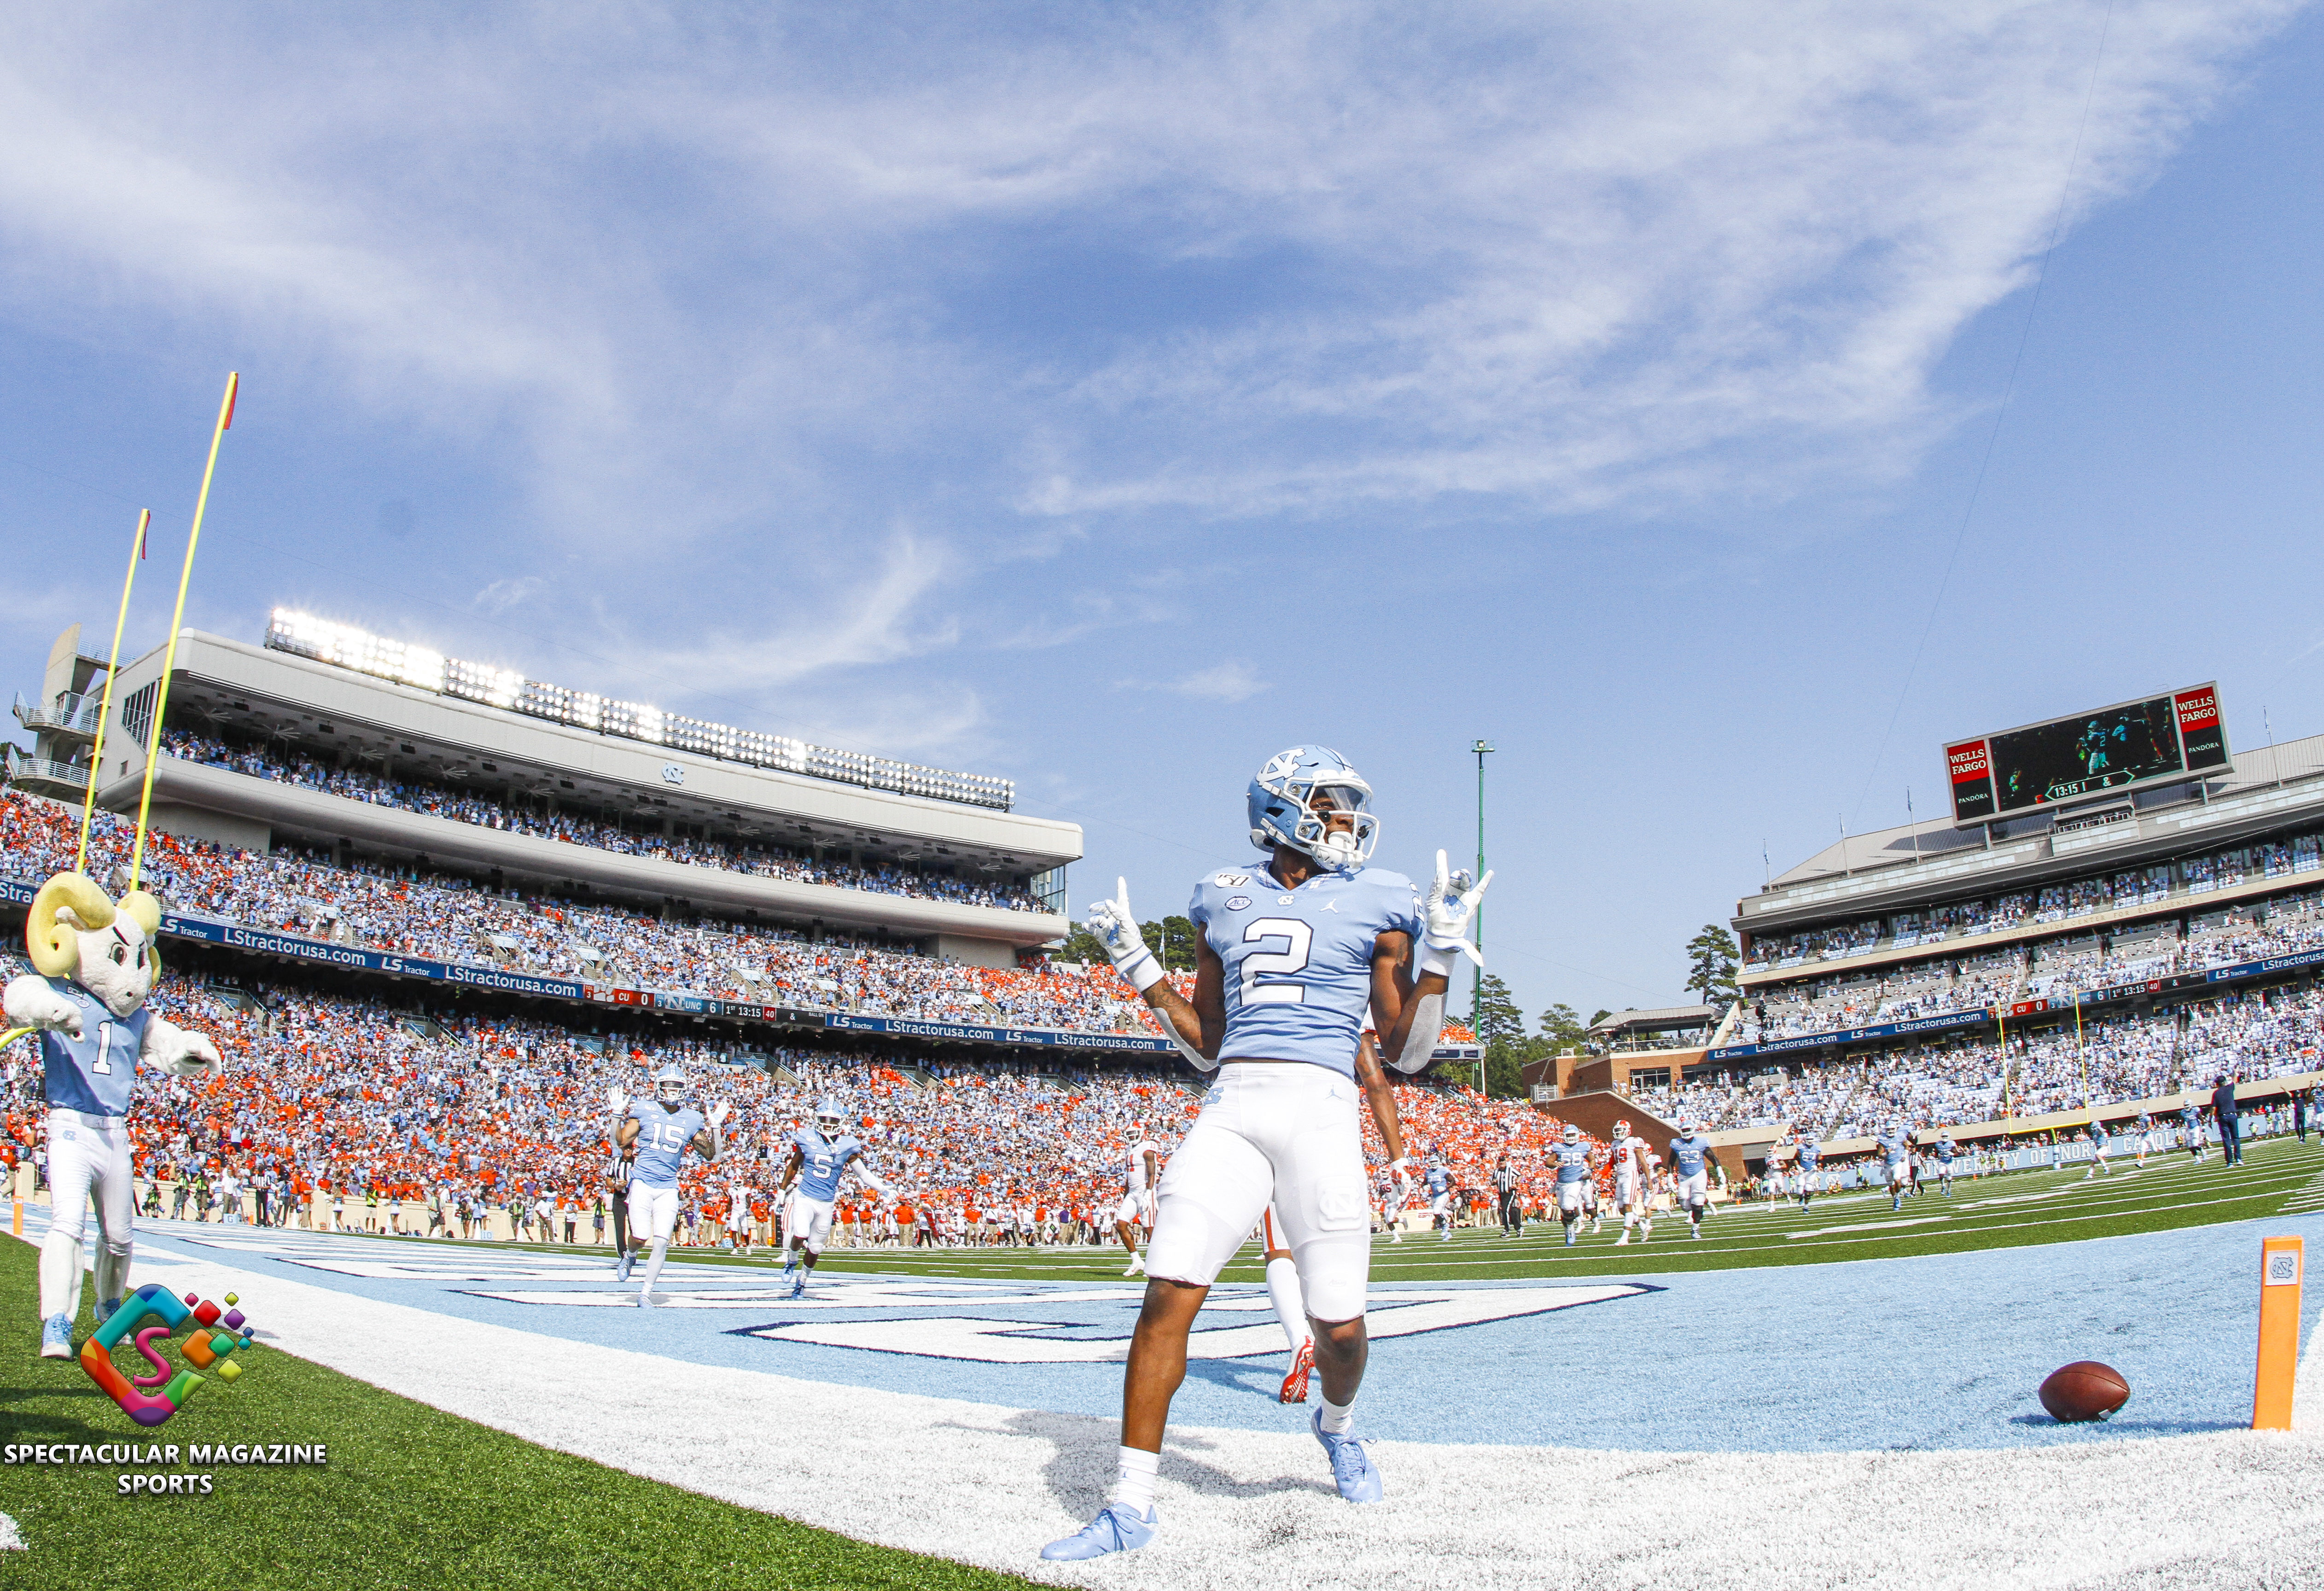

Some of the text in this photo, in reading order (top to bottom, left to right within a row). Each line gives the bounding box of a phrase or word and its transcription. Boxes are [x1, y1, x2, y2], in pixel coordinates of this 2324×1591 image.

[2178, 696, 2214, 711] WELLS
[2181, 708, 2216, 723] FARGO
[1950, 749, 1985, 763] WELLS
[1952, 760, 1986, 774] FARGO
[2055, 783, 2079, 797] 13:15
[2007, 922, 2064, 938] LOUDERMILK
[2072, 915, 2106, 926] CENTER
[2138, 898, 2194, 914] EXCELLENCE
[180, 926, 208, 938] Tractor
[224, 928, 366, 966] LStractorusa.com
[382, 957, 430, 976] LS Tractor
[1240, 917, 1314, 1006] 2
[445, 965, 576, 997] LStractorusa.com
[2215, 969, 2230, 979] LS
[618, 993, 648, 1005] CU 0
[2097, 991, 2104, 1000] 6
[2113, 989, 2121, 998] 1ST
[2124, 984, 2145, 995] 13:15
[686, 1000, 701, 1010] UNC
[710, 1002, 716, 1013] 6
[726, 1005, 735, 1014] 1ST
[739, 1006, 761, 1017] 13:15
[2017, 1001, 2043, 1013] CU 0
[833, 1016, 873, 1030] LS Tractor
[886, 1020, 994, 1039] LStractorusa.com
[1895, 1011, 1980, 1033] LStractorusa.com
[1006, 1031, 1021, 1041] LS
[1055, 1034, 1155, 1050] LStractorusa.com
[1851, 1030, 1864, 1039] LS
[93, 1020, 112, 1076] 1
[1714, 1049, 1726, 1058] LS
[649, 1122, 685, 1154] 15
[1564, 1152, 1584, 1166] 68
[1802, 1151, 1817, 1162] 67
[2029, 1148, 2049, 1165] OF
[812, 1152, 834, 1179] 5
